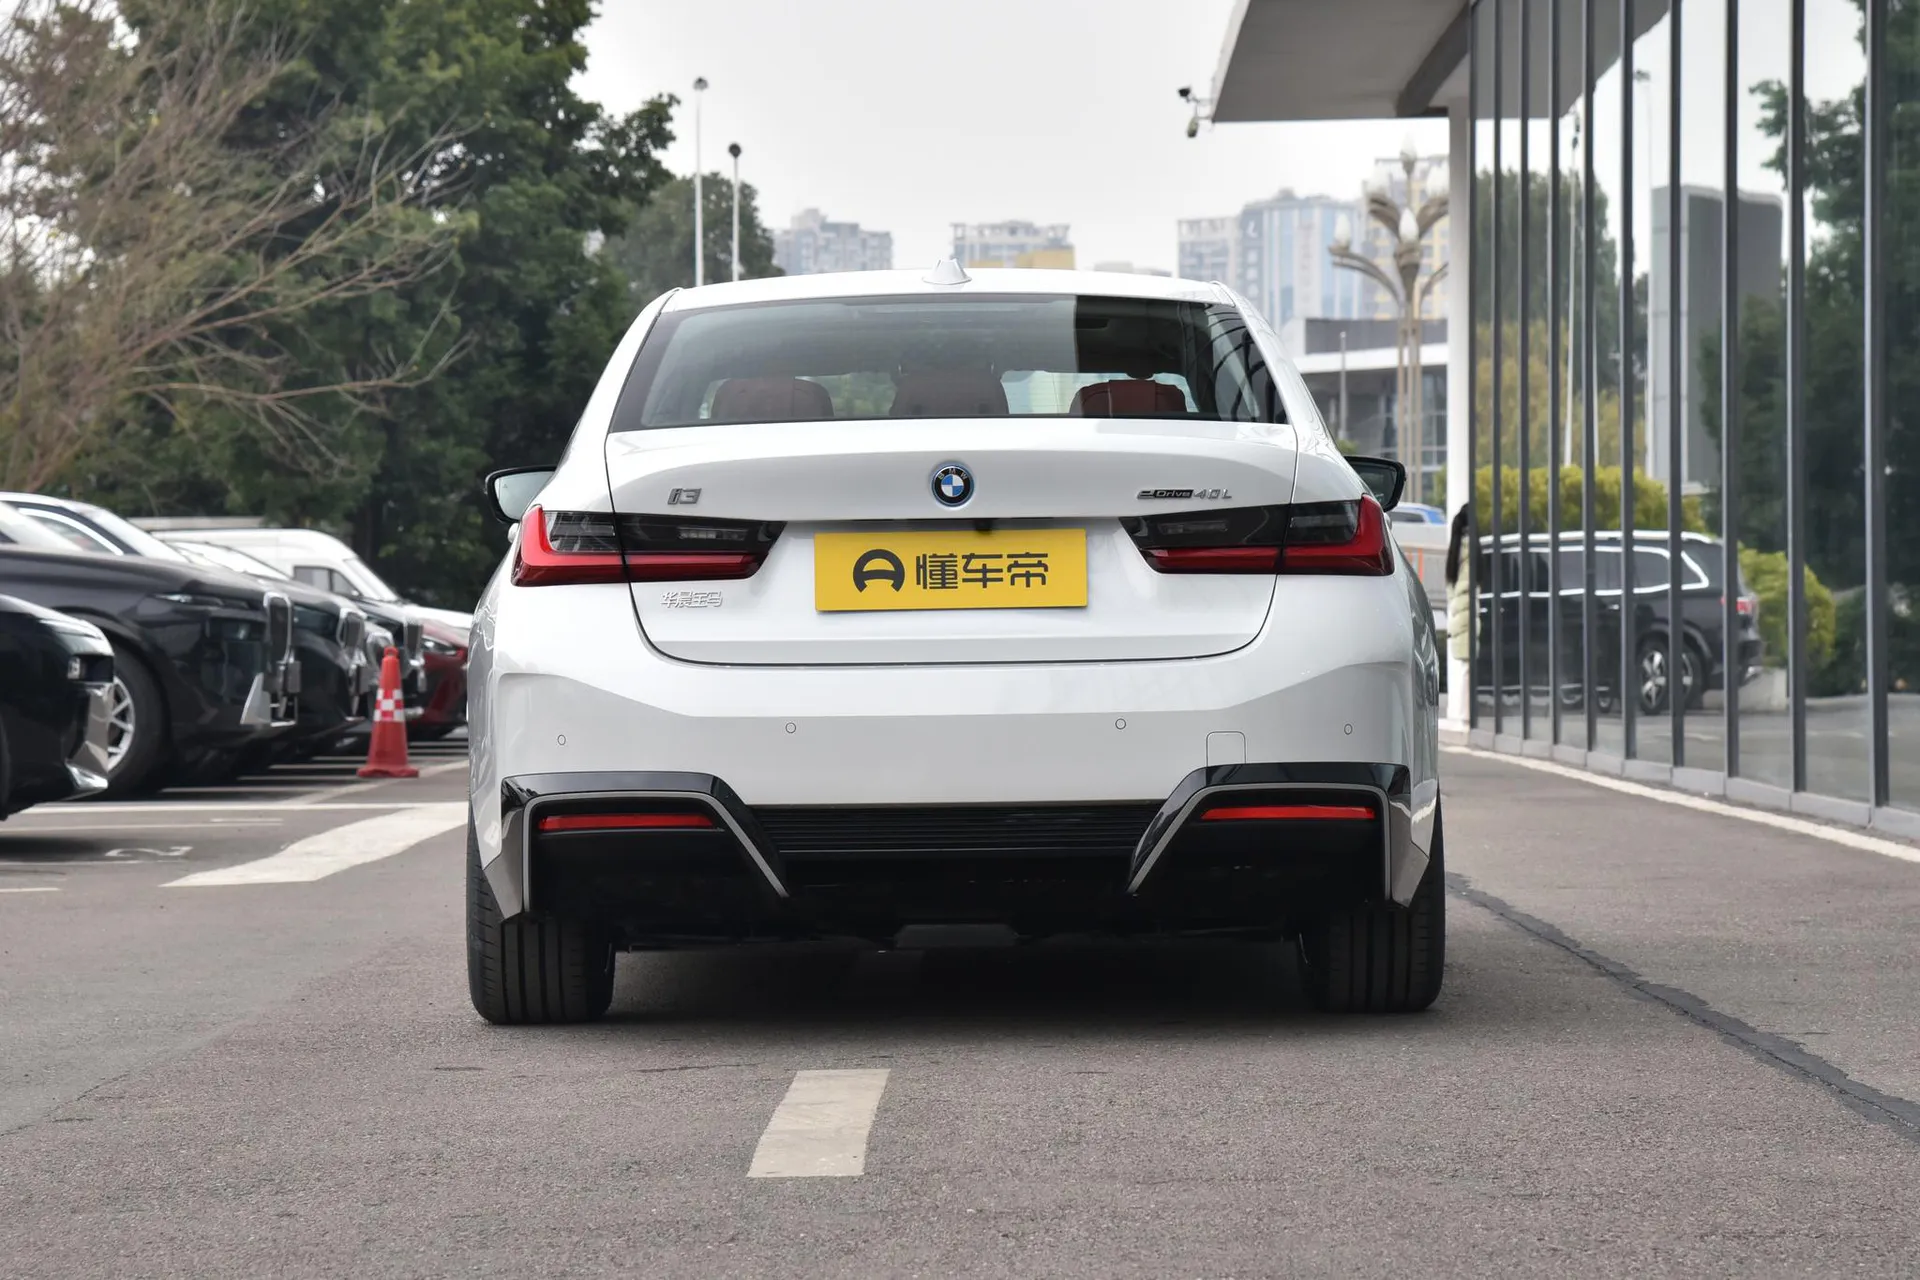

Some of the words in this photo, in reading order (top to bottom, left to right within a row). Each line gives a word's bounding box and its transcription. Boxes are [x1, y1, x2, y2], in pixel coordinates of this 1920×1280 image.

[937, 468, 968, 480] BMW
[667, 488, 702, 505] i3
[916, 552, 1049, 590] 懂车帝
[660, 591, 723, 608] 华晨宝马
